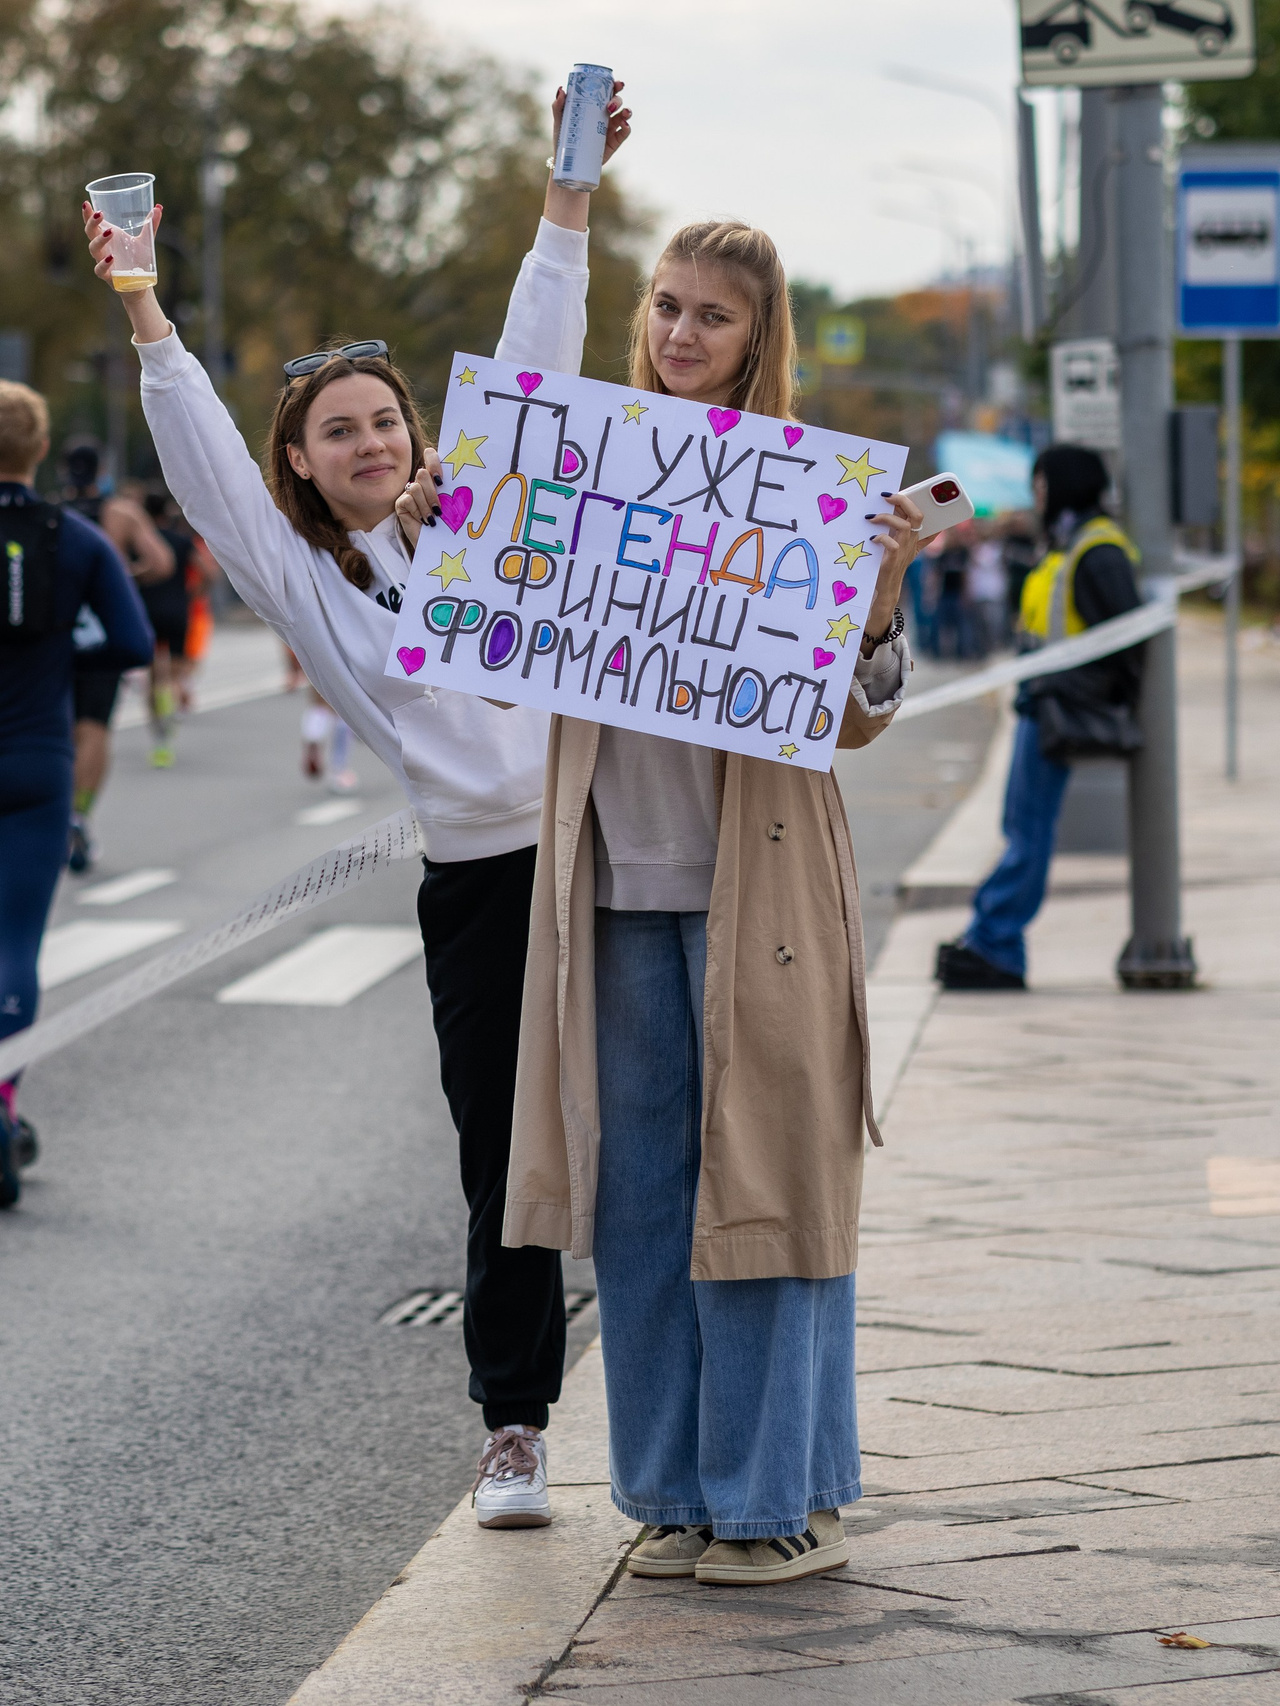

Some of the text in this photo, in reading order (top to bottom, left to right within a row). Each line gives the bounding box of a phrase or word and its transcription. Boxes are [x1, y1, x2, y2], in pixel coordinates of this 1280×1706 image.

[484, 391, 817, 531] ТЫ УЖЕ
[467, 473, 819, 609] ЛЕГЕНДА
[423, 597, 834, 741] ФОРМАЛЬНОСТЬ
